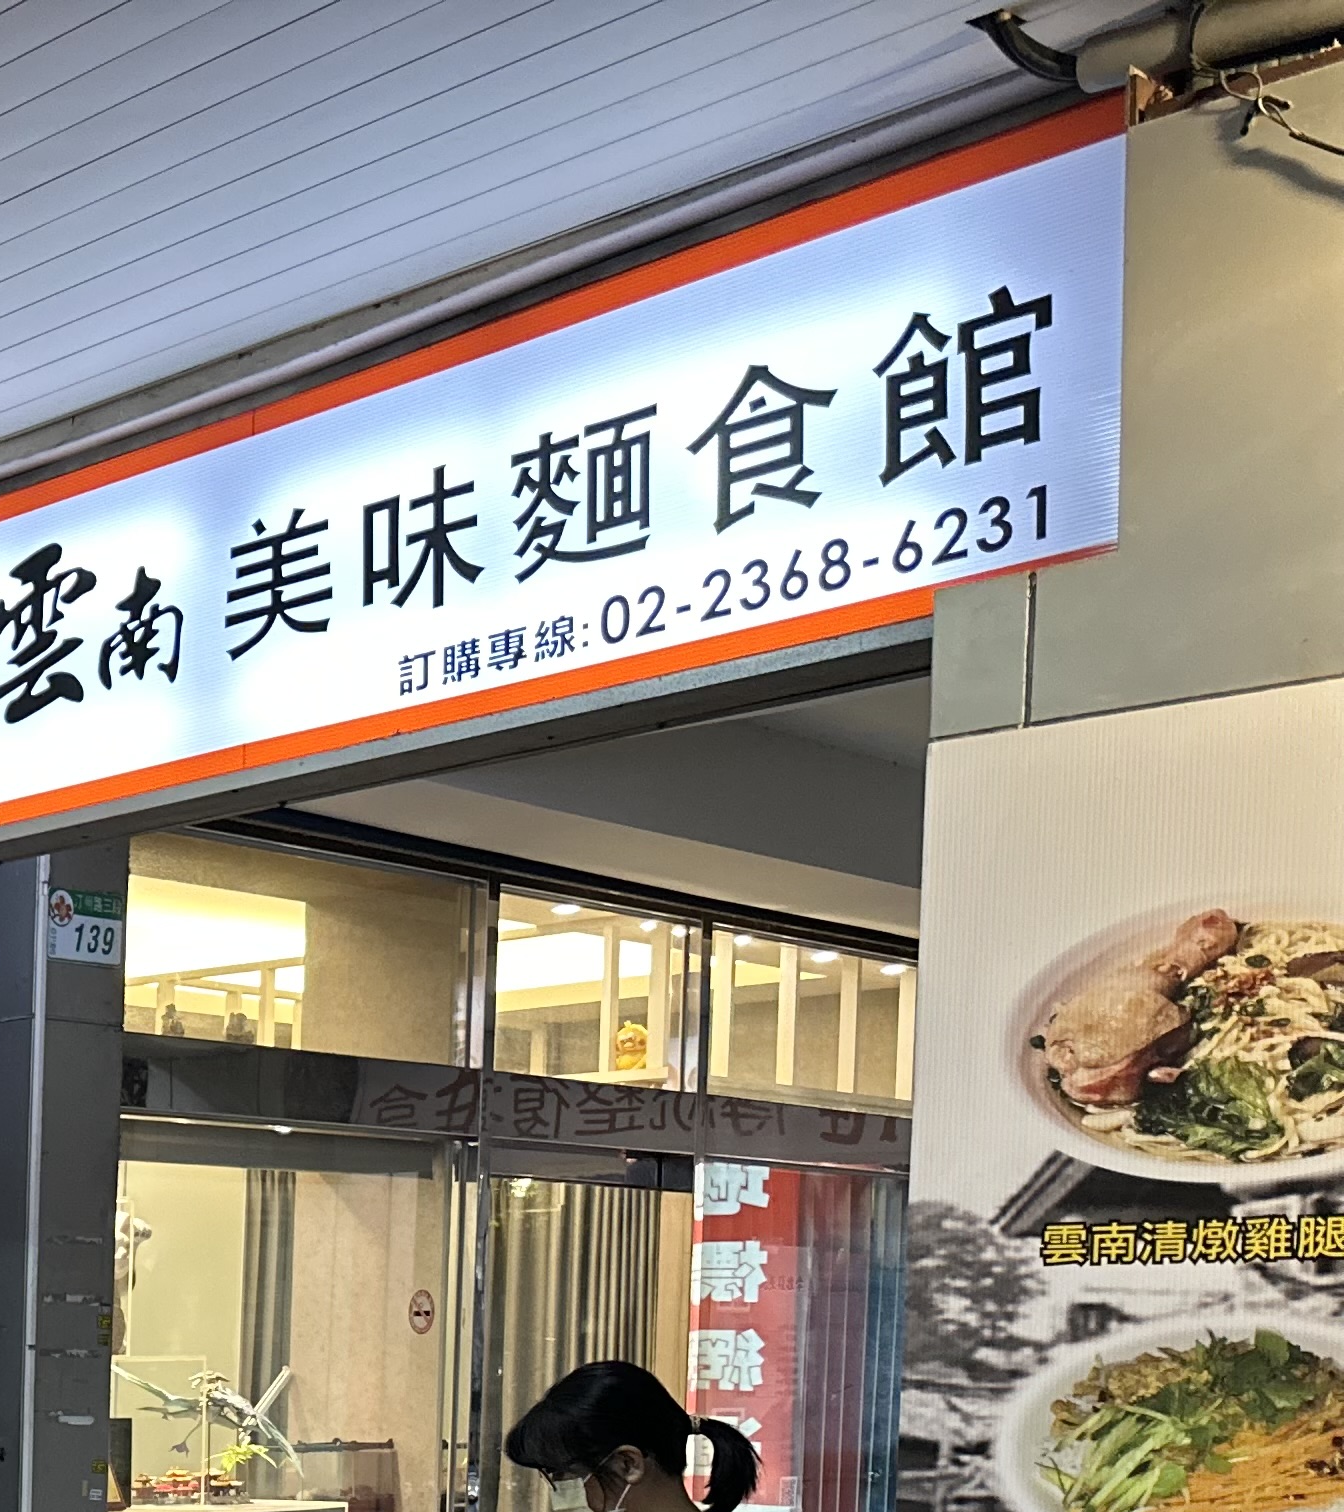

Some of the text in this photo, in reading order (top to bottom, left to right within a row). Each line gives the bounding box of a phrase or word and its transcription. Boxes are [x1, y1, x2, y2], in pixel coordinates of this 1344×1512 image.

[225, 285, 1053, 661] 美味麵食館
[601, 484, 1050, 646] 02-2368-6231
[75, 923, 114, 955] 139
[1040, 1216, 1344, 1265] 雲南清燉雞腿
